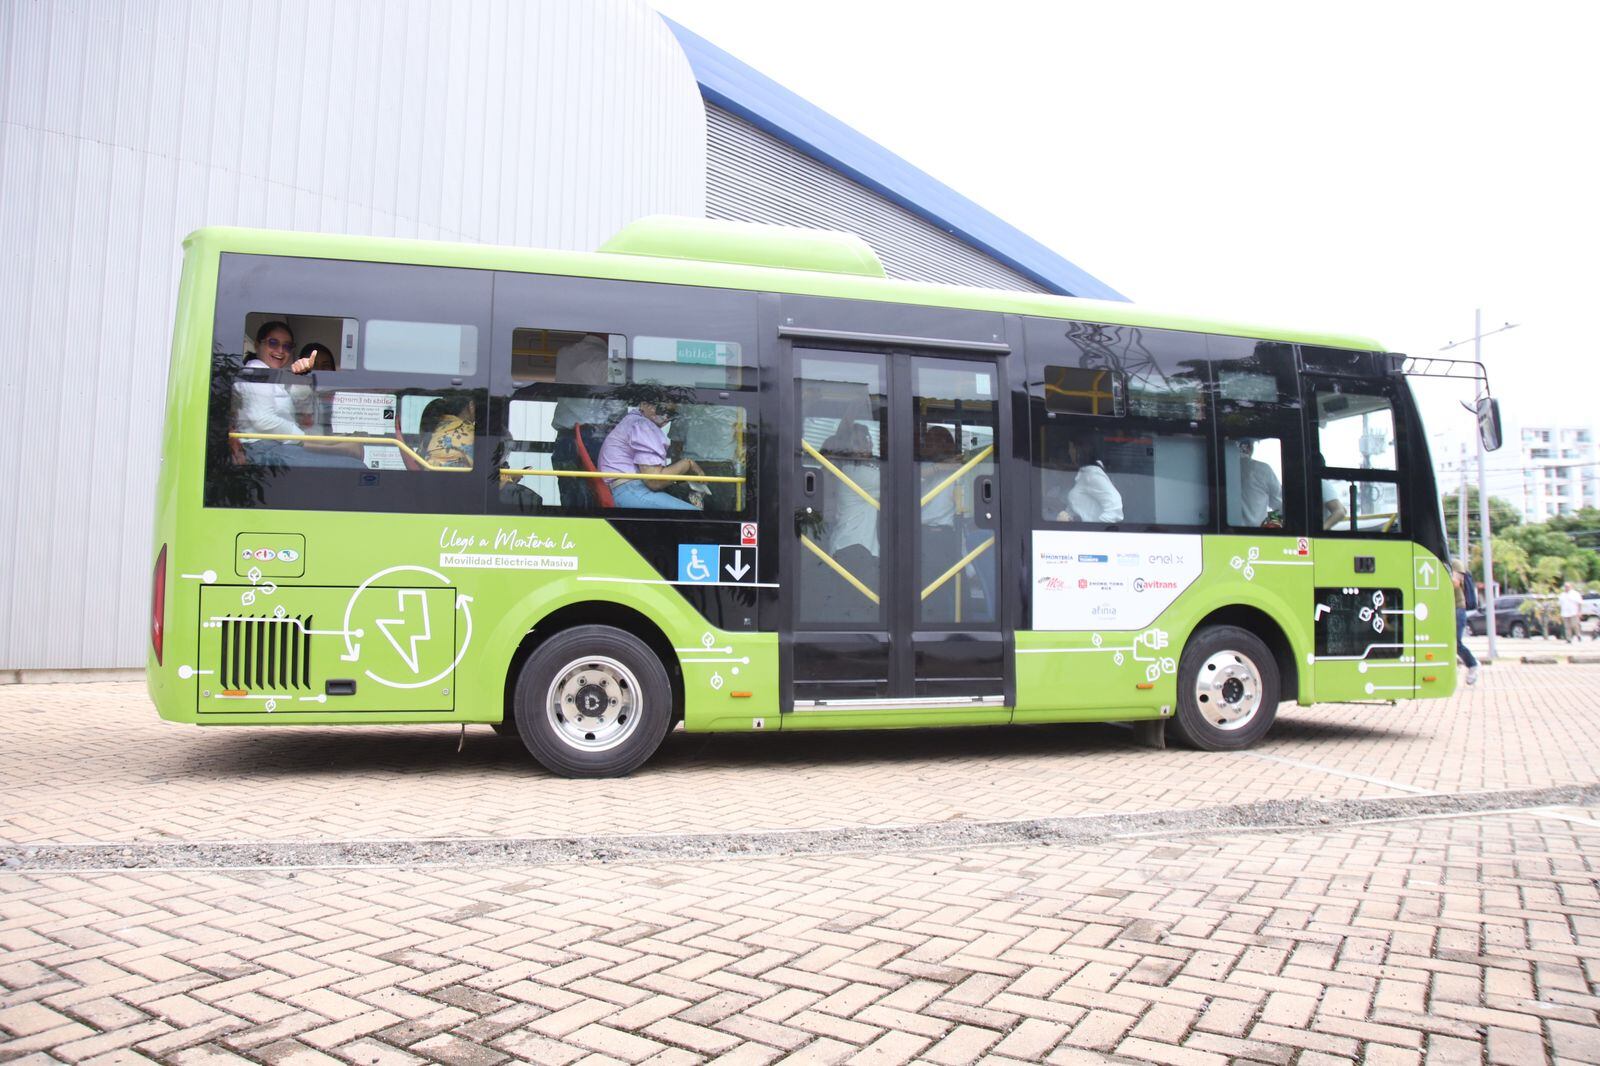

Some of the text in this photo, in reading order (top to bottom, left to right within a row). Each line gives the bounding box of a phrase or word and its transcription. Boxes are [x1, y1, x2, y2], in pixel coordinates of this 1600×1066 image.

[494, 528, 557, 550] Montería
[561, 533, 577, 549] la
[444, 556, 574, 568] Movilidad Eléctrica Masiva
[1148, 554, 1173, 565] enel
[1133, 577, 1177, 592] Navitrans
